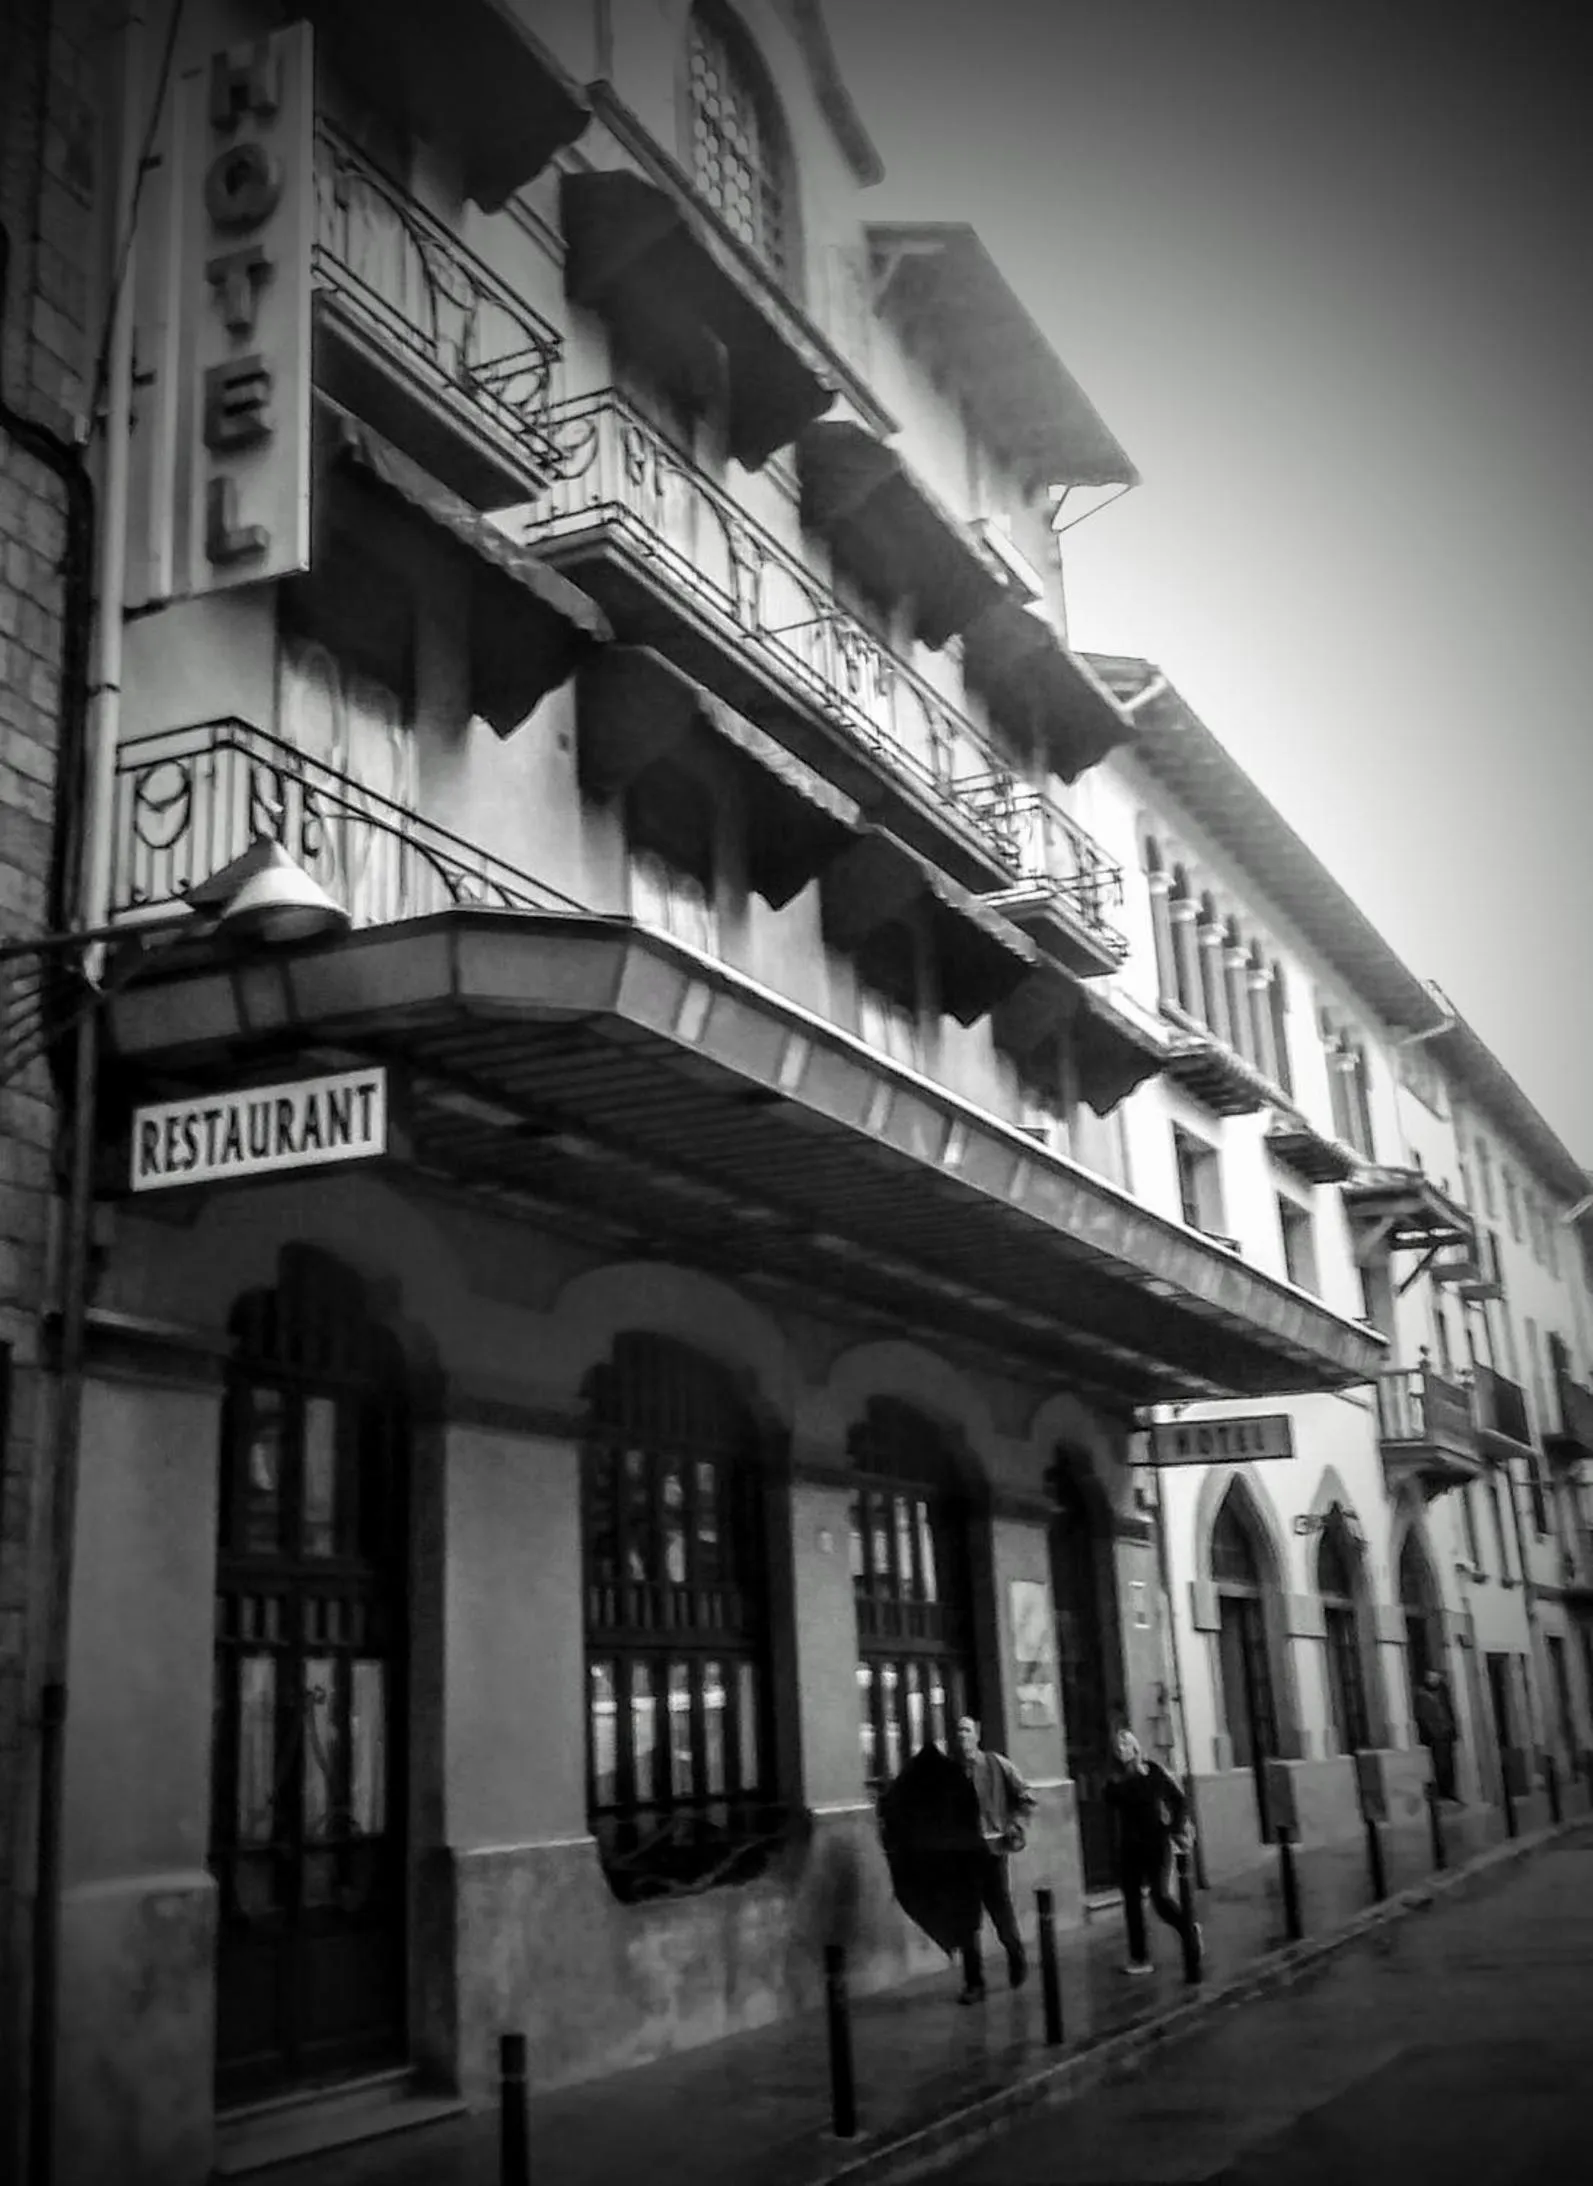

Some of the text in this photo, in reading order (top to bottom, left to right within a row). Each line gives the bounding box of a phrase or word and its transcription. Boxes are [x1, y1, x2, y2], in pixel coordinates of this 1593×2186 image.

[203, 39, 281, 568] HOTEL
[140, 1082, 376, 1176] RESTAURANT
[1175, 1423, 1265, 1456] HOTEL
